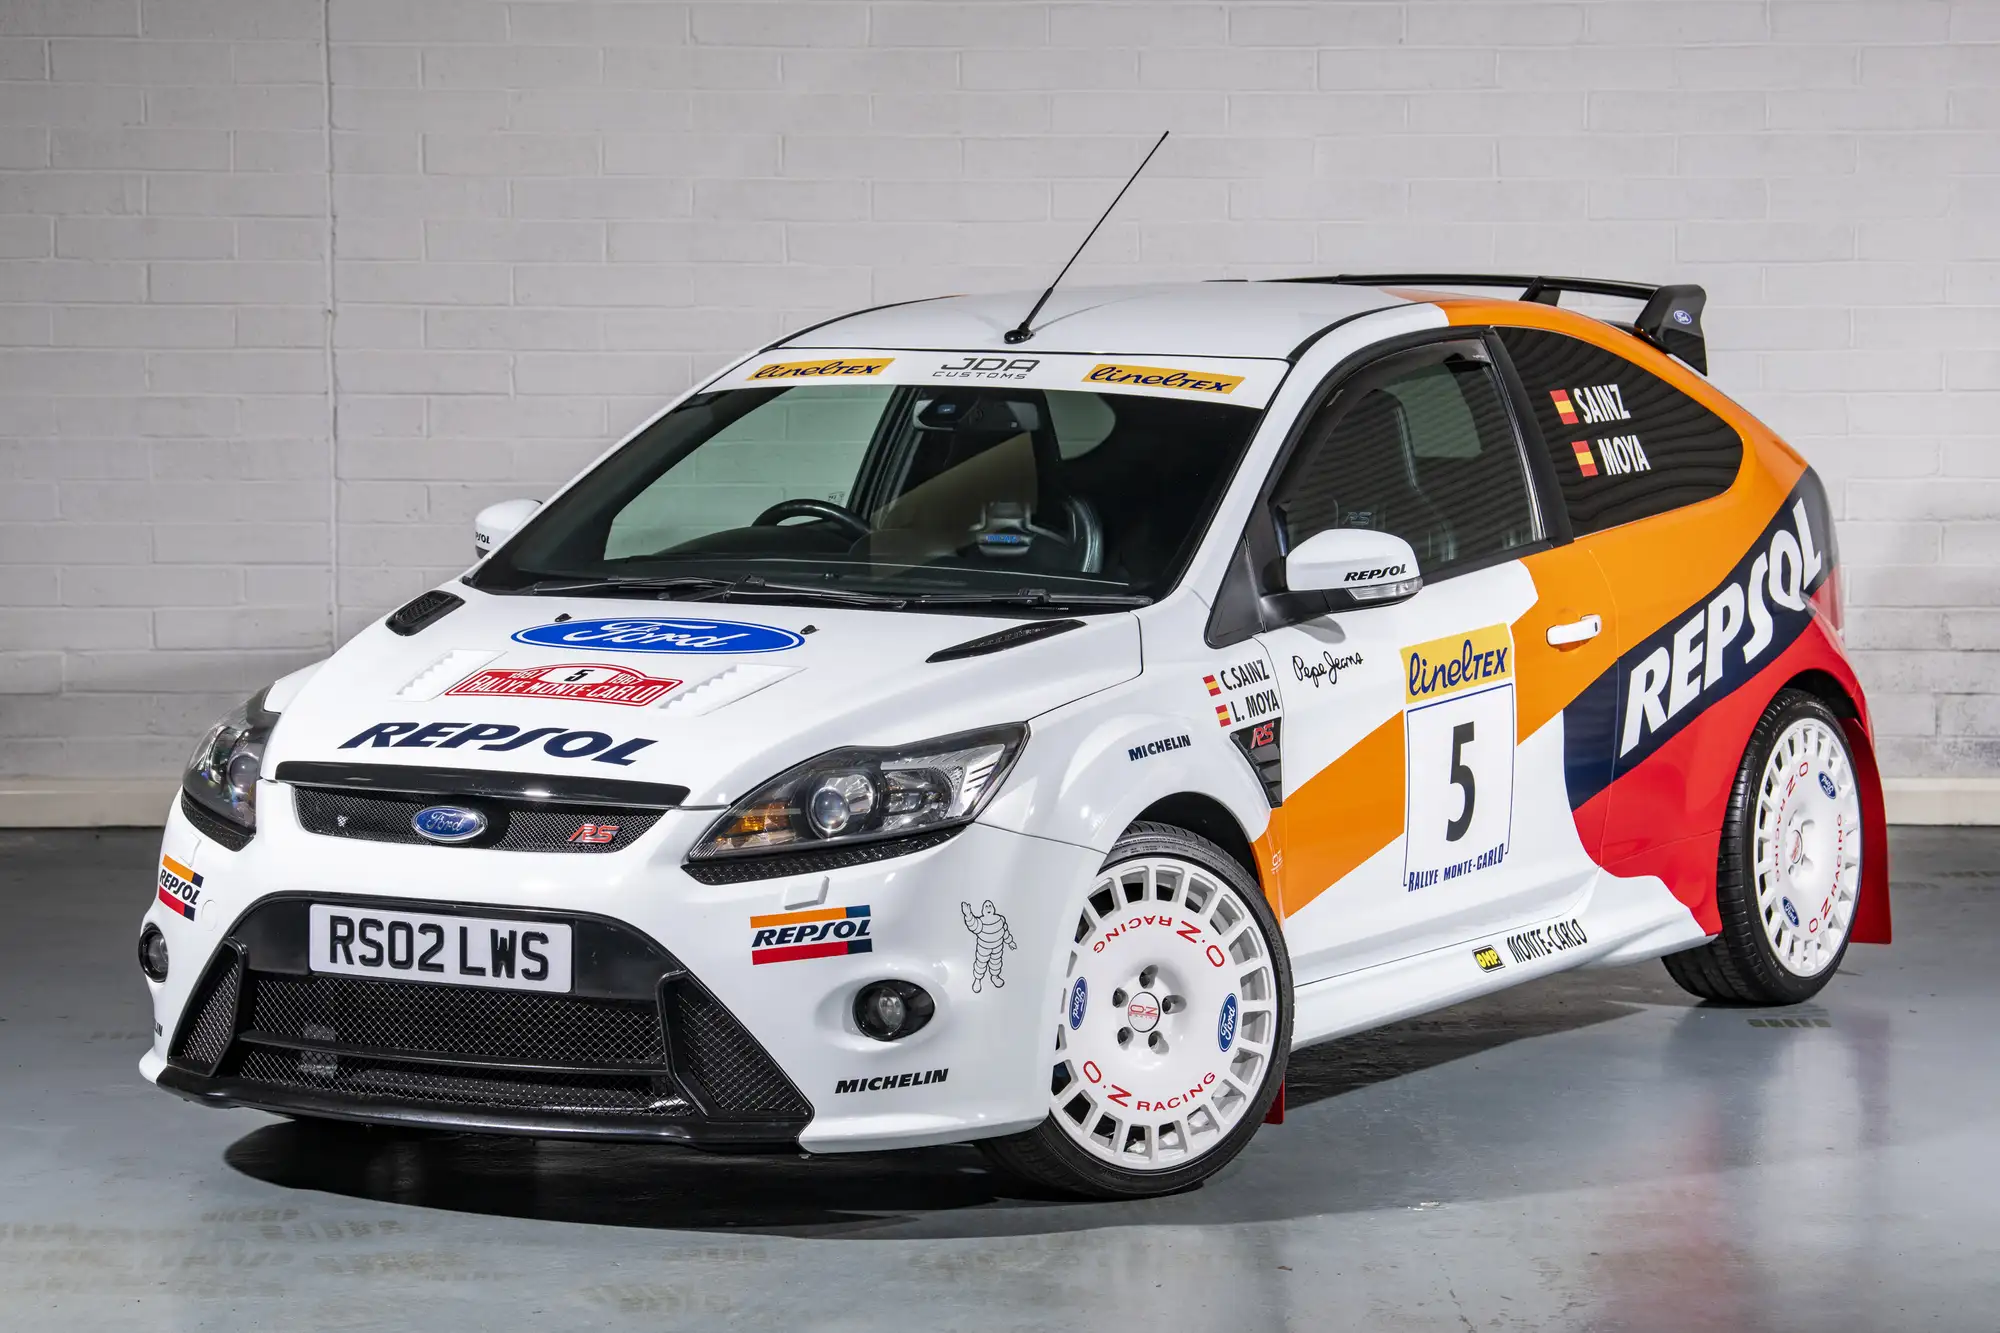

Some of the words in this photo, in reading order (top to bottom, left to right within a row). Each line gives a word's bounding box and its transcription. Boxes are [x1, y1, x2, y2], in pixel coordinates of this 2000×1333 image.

[932, 371, 1027, 380] CUSTOMS
[941, 357, 1041, 373] JDA
[1572, 383, 1631, 425] SAINZ
[1598, 434, 1652, 476] MOYA
[1344, 563, 1407, 582] REPSOL
[562, 621, 751, 648] Ford
[1619, 497, 1822, 760] REPSOL
[563, 669, 595, 682] 5
[1291, 654, 1328, 687] Pepe
[1325, 650, 1364, 684] Jeans
[464, 675, 532, 694] RALLYE
[527, 680, 662, 702] MONTE-CARLO
[1230, 700, 1246, 723] L.
[1244, 688, 1281, 719] MOYA
[337, 722, 659, 767] REPSOL
[1127, 734, 1192, 762] MICHELIN
[1250, 720, 1275, 750] RS
[1445, 720, 1476, 843] 5
[425, 810, 464, 833] Ford
[566, 823, 621, 844] RS
[1407, 868, 1439, 893] RALLYE
[1443, 842, 1505, 882] MONTE-CARLO
[159, 868, 201, 906] REPSOL
[328, 914, 445, 974] RS02
[458, 925, 550, 982] LWS
[751, 918, 872, 948] REPSOL
[1092, 914, 1174, 954] RACING
[1506, 918, 1588, 964] MONTE-CARLO
[1475, 948, 1499, 969] OMP
[834, 1068, 950, 1095] MICHELIN
[1136, 1071, 1217, 1113] RACING
